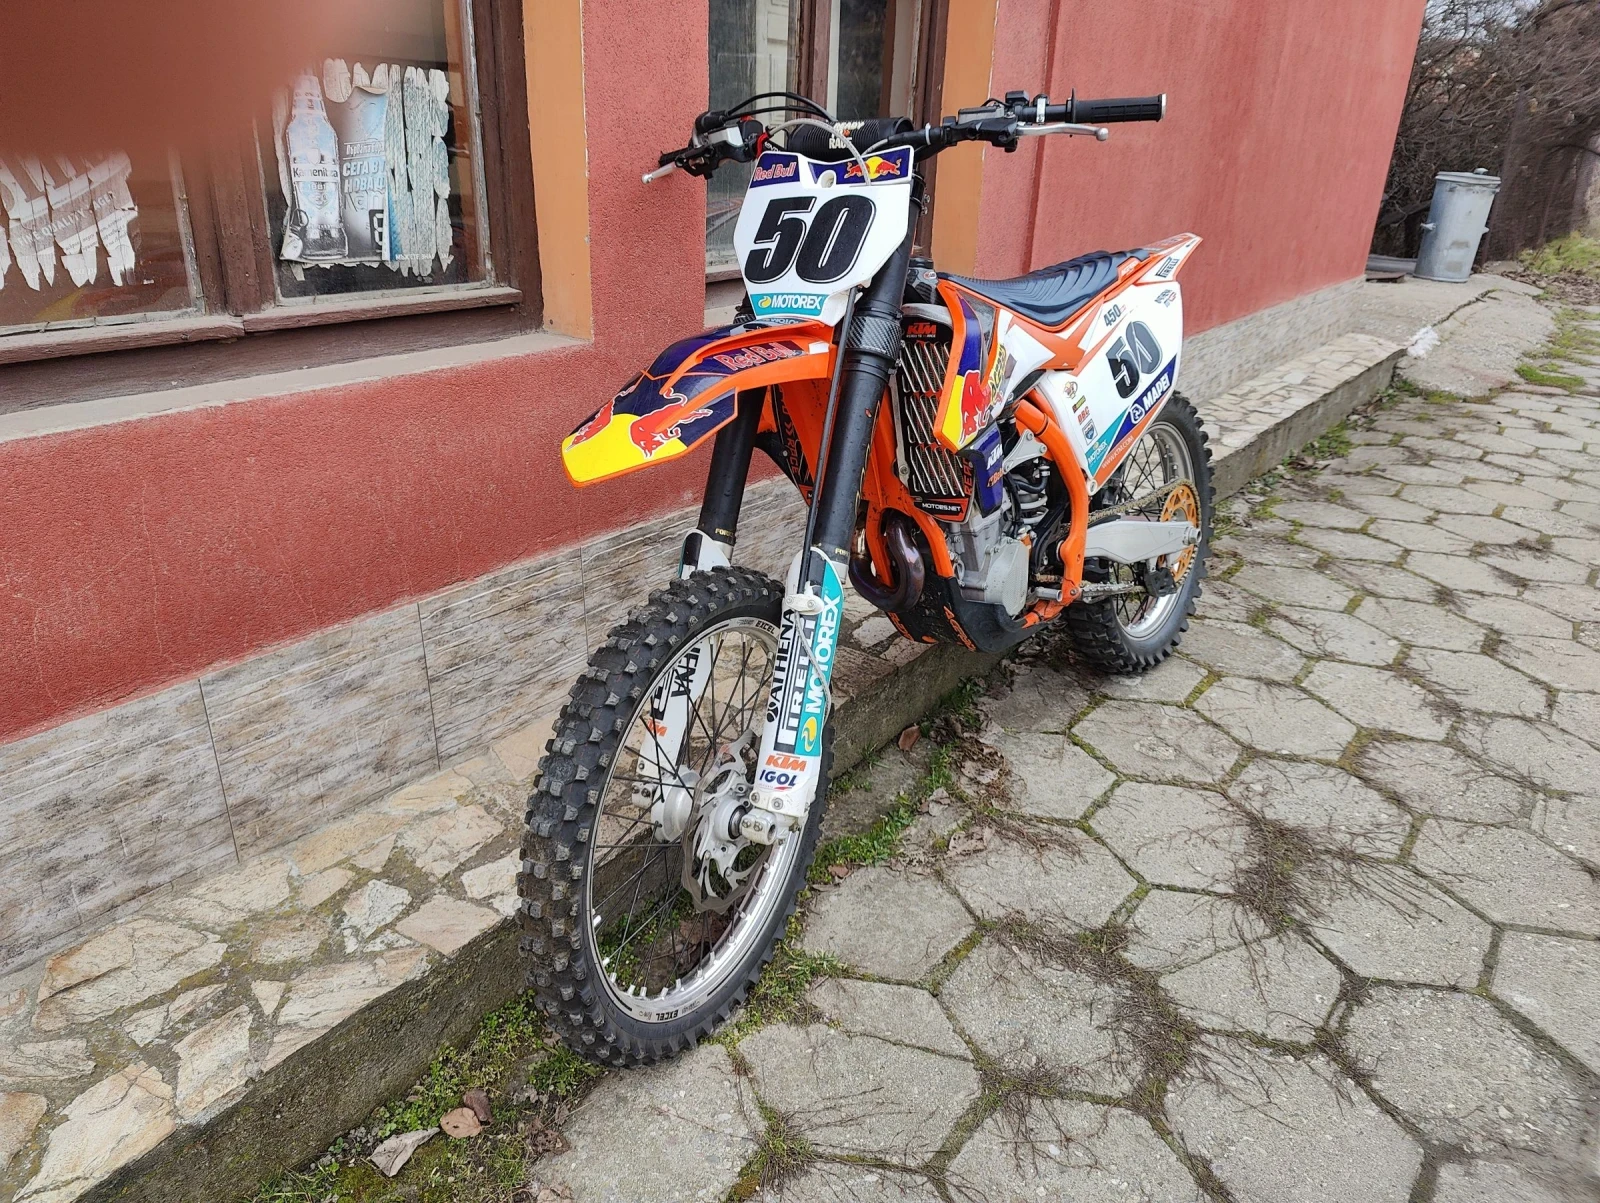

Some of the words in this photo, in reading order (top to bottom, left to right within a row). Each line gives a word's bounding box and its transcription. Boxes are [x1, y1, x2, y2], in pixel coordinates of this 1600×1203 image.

[754, 164, 775, 181] Red
[773, 161, 797, 178] Bull
[41, 208, 88, 236] QUALITY
[744, 194, 876, 284] 50
[1155, 257, 1180, 278] PIRELLI
[771, 294, 823, 310] MOTOREX
[1103, 304, 1122, 327] 450
[907, 322, 937, 335] KTM
[713, 347, 767, 371] Red
[749, 341, 793, 361] Bull
[1105, 320, 1163, 399] 50
[1142, 372, 1171, 411] MAPEI
[755, 620, 776, 634] EXCEL
[770, 609, 795, 702] ATHENA
[805, 595, 840, 715] MOTOREX
[778, 615, 816, 745] PIRELLI
[765, 753, 807, 772] KTM
[759, 769, 797, 787] IGOL
[655, 1009, 678, 1021] EXCEL
